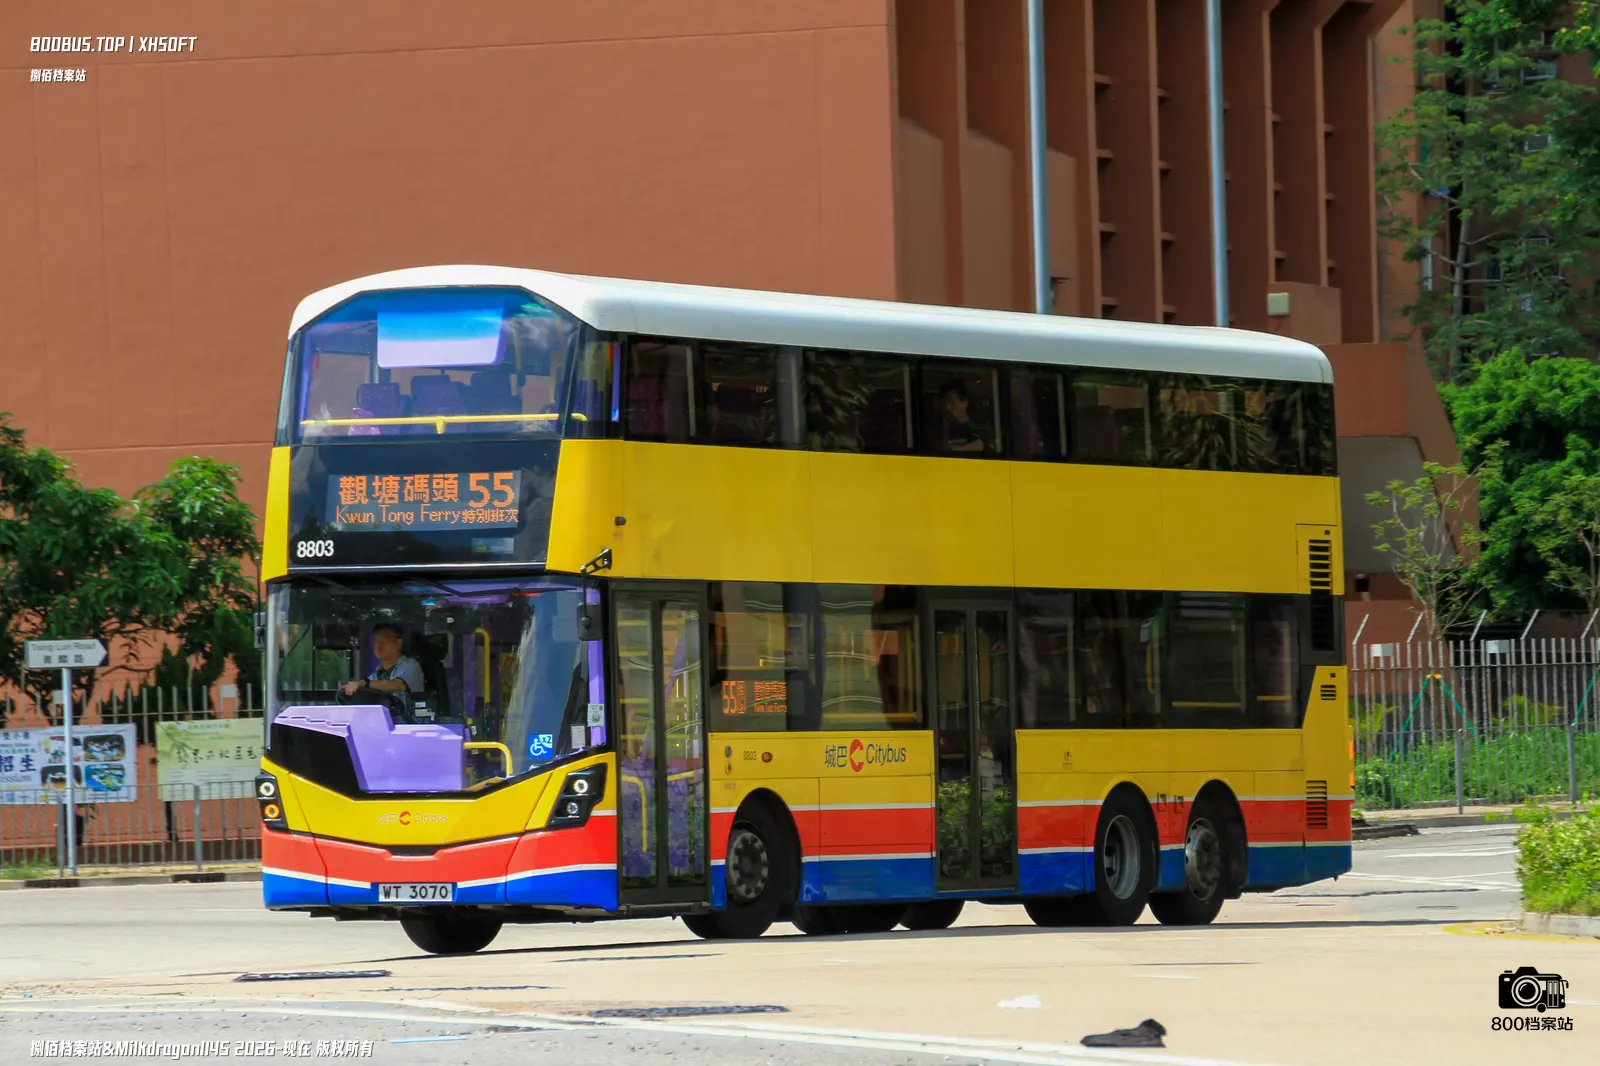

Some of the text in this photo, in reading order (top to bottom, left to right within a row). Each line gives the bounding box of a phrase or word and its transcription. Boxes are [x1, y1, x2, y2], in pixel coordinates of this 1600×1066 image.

[338, 471, 516, 508] 觀塘碼頭 55
[335, 506, 375, 524] Kwun
[378, 504, 415, 525] Tong
[420, 503, 461, 524] Ferry
[296, 539, 335, 559] 8803
[722, 680, 737, 714] 55
[824, 743, 907, 768] 城巴 Citybus
[382, 885, 449, 899] WT 3070
